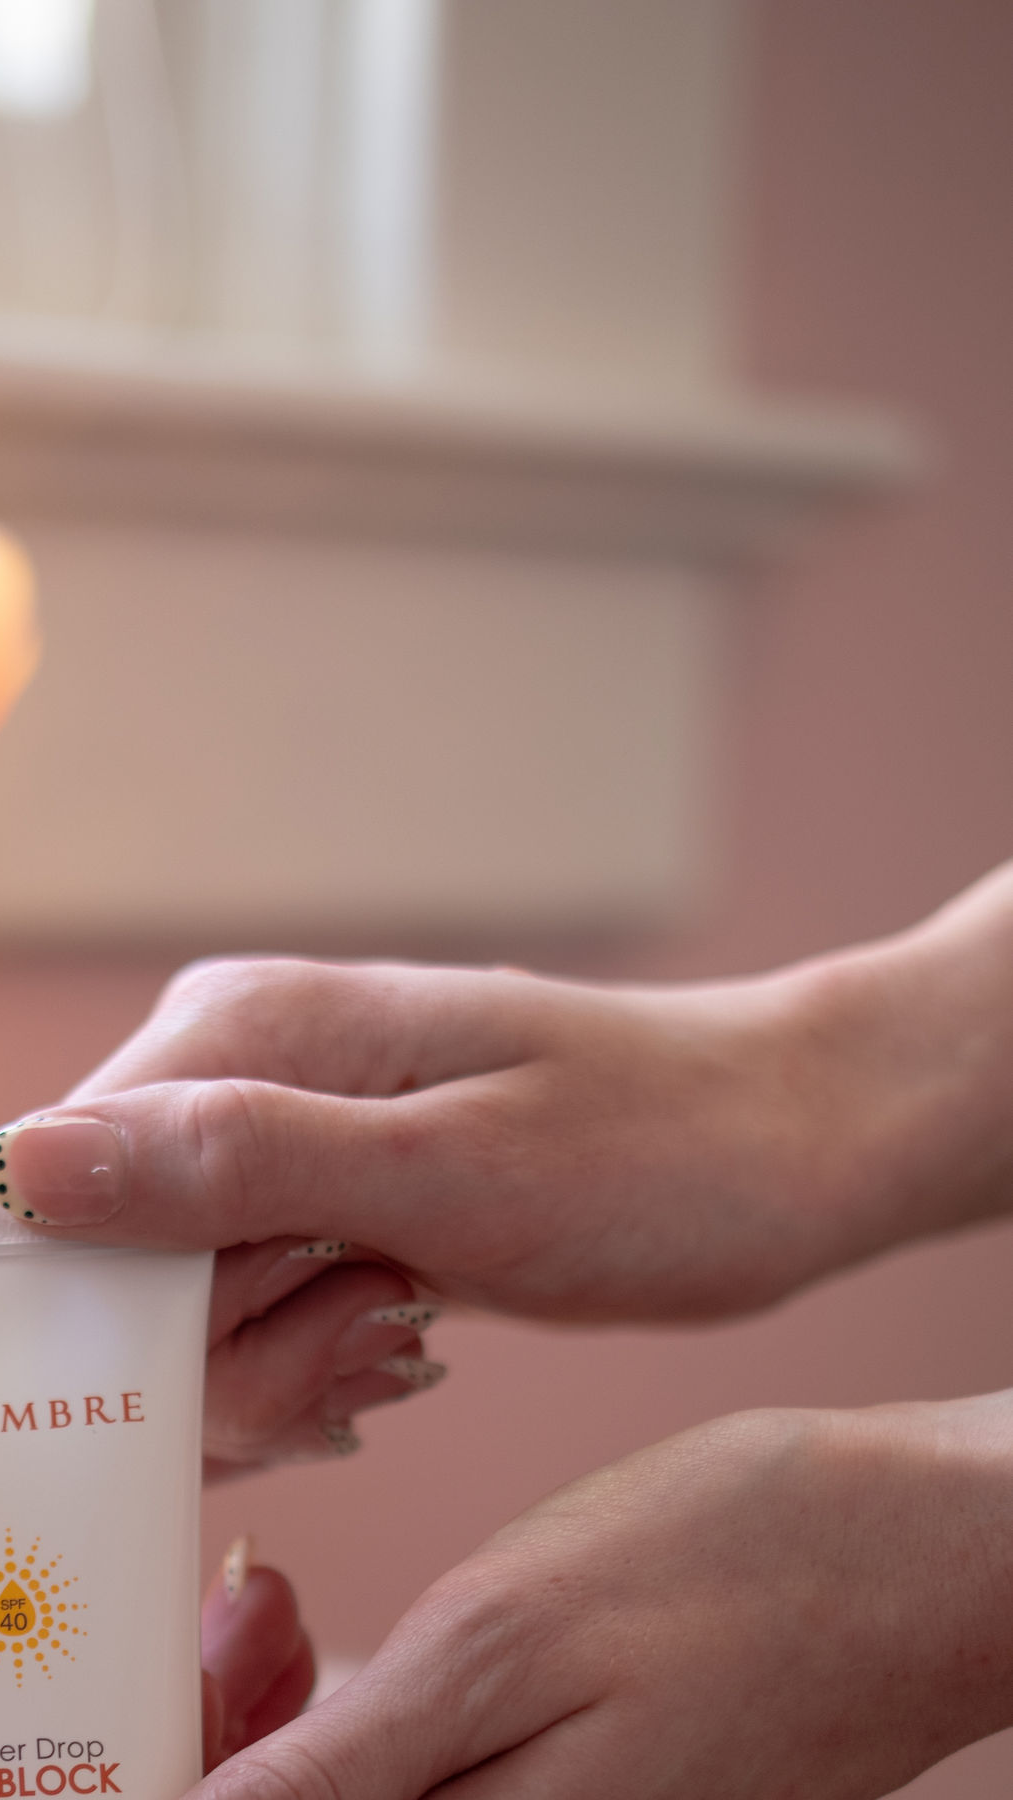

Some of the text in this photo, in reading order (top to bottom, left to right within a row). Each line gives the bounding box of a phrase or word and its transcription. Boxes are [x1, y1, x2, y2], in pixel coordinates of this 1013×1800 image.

[0, 1598, 27, 1611] SPF
[0, 1612, 28, 1632] 40
[36, 1738, 104, 1763] Drop
